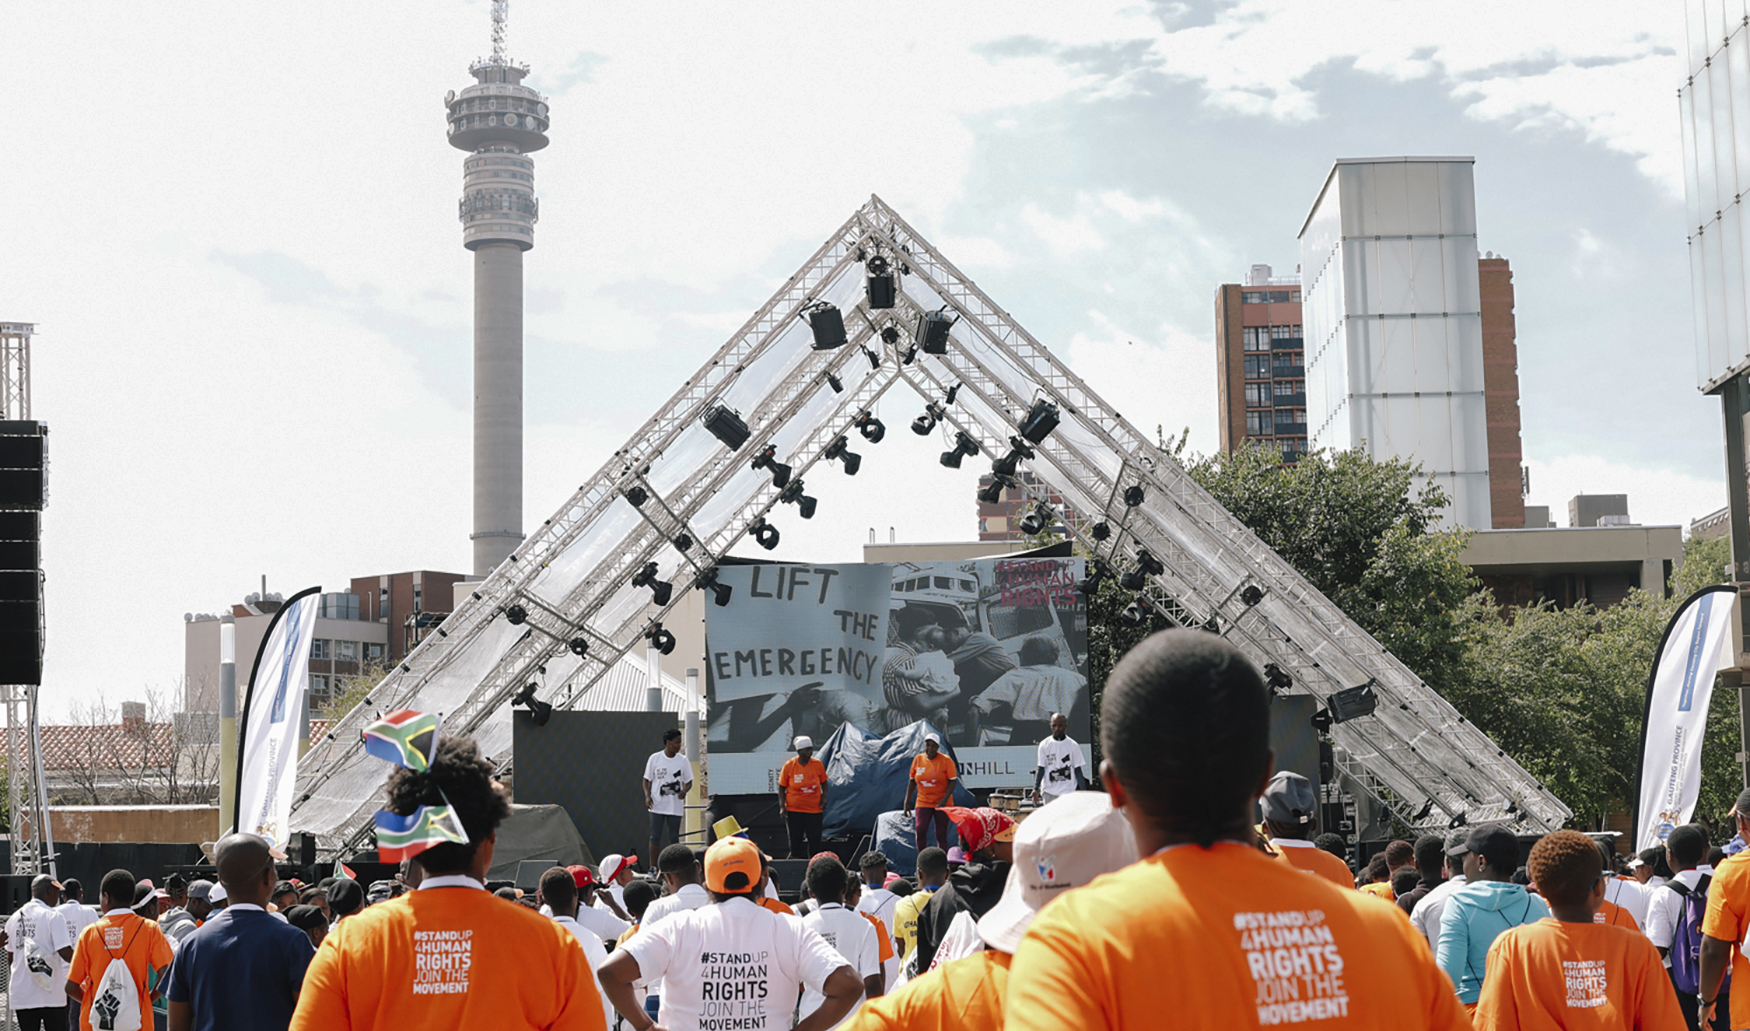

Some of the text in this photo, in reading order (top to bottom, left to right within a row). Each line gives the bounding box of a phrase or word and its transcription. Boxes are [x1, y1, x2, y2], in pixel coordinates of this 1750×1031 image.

[751, 565, 839, 604] LIFT
[1001, 586, 1076, 607] RIGHTS
[833, 609, 878, 641] THE
[715, 647, 878, 684] EMERGENCY
[1672, 725, 1683, 765] PROVINCE
[268, 738, 277, 778] PROVINCE
[1667, 765, 1678, 805] GAUTENG
[1233, 909, 1326, 931] #STANDUP
[414, 930, 473, 941] #STANDUP
[1240, 925, 1334, 950] 4HUMAN
[415, 940, 472, 953] 4HUMAN
[416, 952, 472, 970] RIGHTS
[701, 951, 768, 964] #STANDUP
[1247, 944, 1344, 980] RIGHTS
[1563, 960, 1605, 968] #STANDUP
[413, 968, 469, 983] JOIN THE
[701, 964, 767, 979] 4HUMAN
[1564, 968, 1605, 977] 4HUMAN
[413, 982, 469, 994] MOVEMENT
[702, 980, 768, 1000] RIGHTS
[1255, 970, 1347, 1004] JOIN THE
[1565, 977, 1607, 990] RIGHTS
[1566, 987, 1605, 999] JOIN THE
[699, 999, 766, 1017] JOIN THE
[1256, 995, 1350, 1026] MOVEMENT
[1566, 997, 1607, 1008] MOVEMENT
[699, 1015, 766, 1031] MOVEMENT
